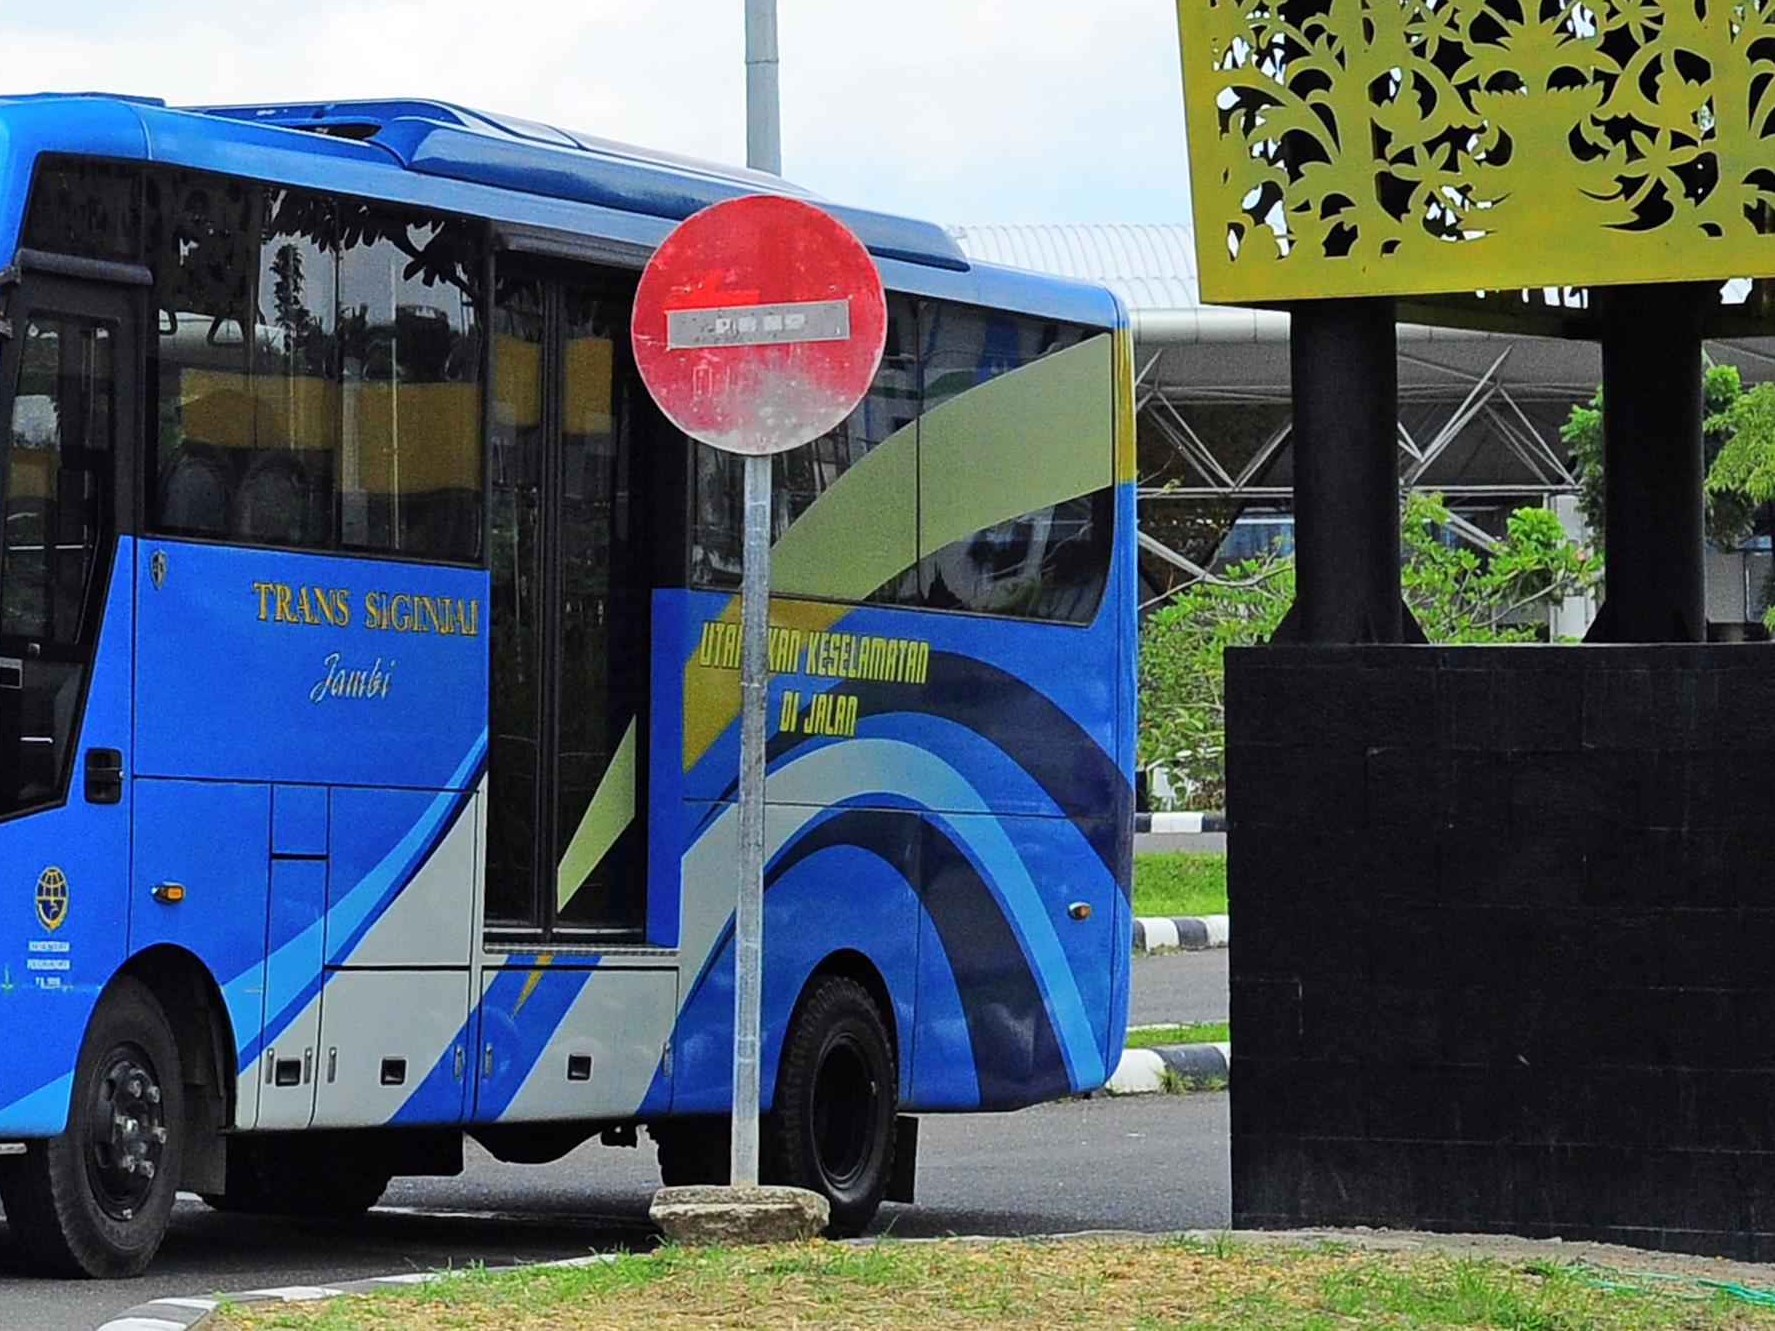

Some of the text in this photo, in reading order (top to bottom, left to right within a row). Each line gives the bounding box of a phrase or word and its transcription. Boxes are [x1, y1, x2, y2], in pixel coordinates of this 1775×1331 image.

[252, 580, 478, 636] TRANS SIGINJAI
[309, 652, 396, 704] Jambi
[700, 622, 929, 685] UTAKAN KESELAMATAN
[779, 690, 859, 737] DI JALAN
